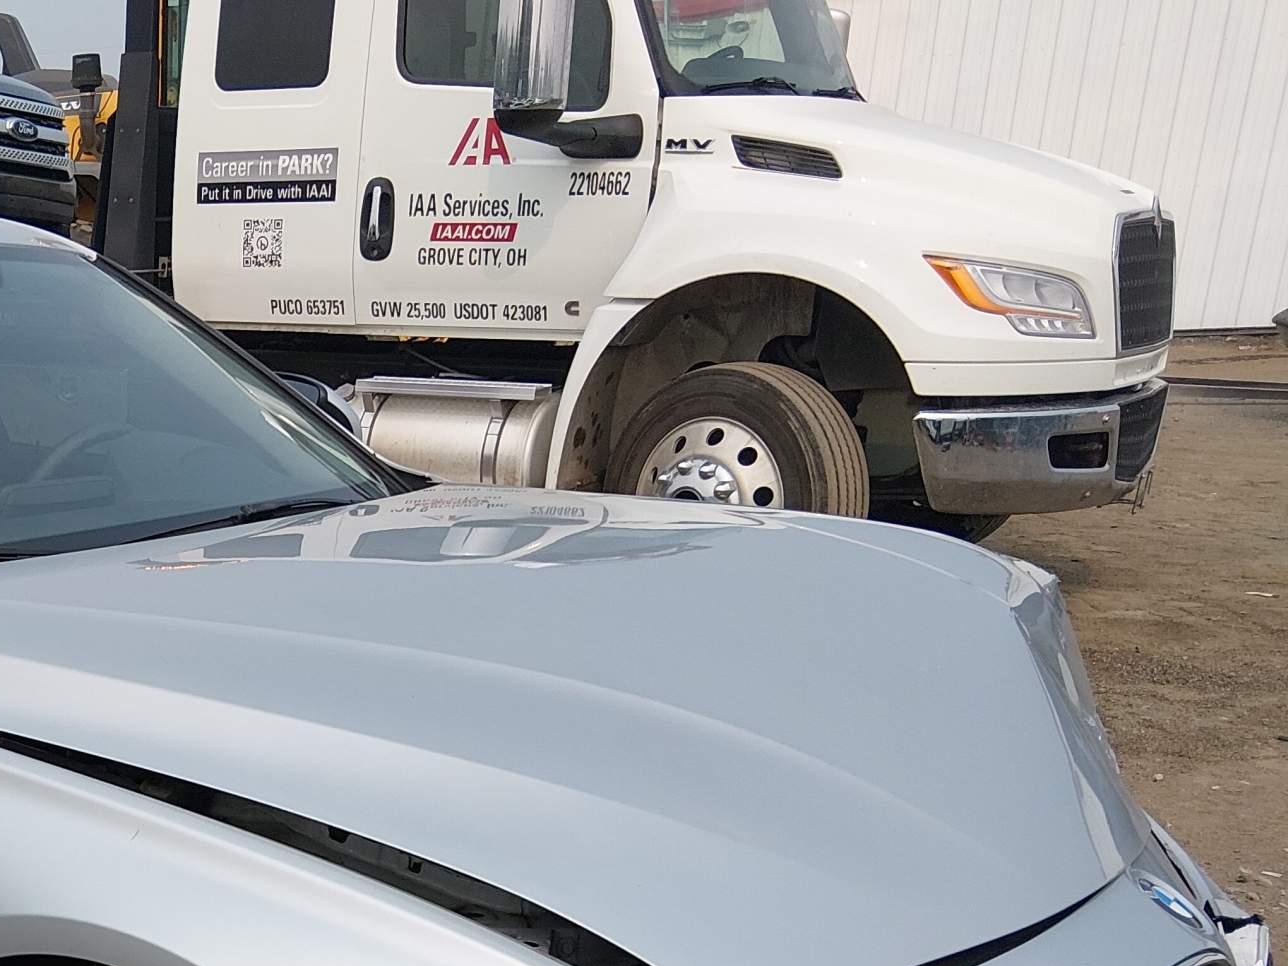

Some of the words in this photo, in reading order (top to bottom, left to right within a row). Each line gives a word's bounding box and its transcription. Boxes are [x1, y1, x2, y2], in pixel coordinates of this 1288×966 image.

[665, 138, 713, 150] MV
[202, 157, 254, 178] Career
[259, 156, 272, 176] in
[277, 153, 334, 176] PARK?
[201, 186, 220, 201] Put
[222, 185, 231, 200] it
[233, 185, 243, 200] in
[246, 184, 274, 200] Drive
[277, 183, 302, 199] with
[306, 183, 333, 199] IAAI
[568, 171, 632, 196] 22104662
[408, 192, 437, 217] IAA
[443, 192, 514, 220] Services,
[517, 192, 544, 218] Inc.
[435, 224, 511, 240] IAAI.COM
[417, 247, 465, 266] GROVE
[468, 247, 502, 269] CITY,
[506, 247, 528, 267] OH
[270, 299, 302, 315] PUCO
[306, 299, 346, 316] 653751
[370, 300, 402, 318] GVW
[406, 301, 446, 320] 25,500
[454, 302, 498, 320] USDOT
[502, 303, 549, 322] 423081
